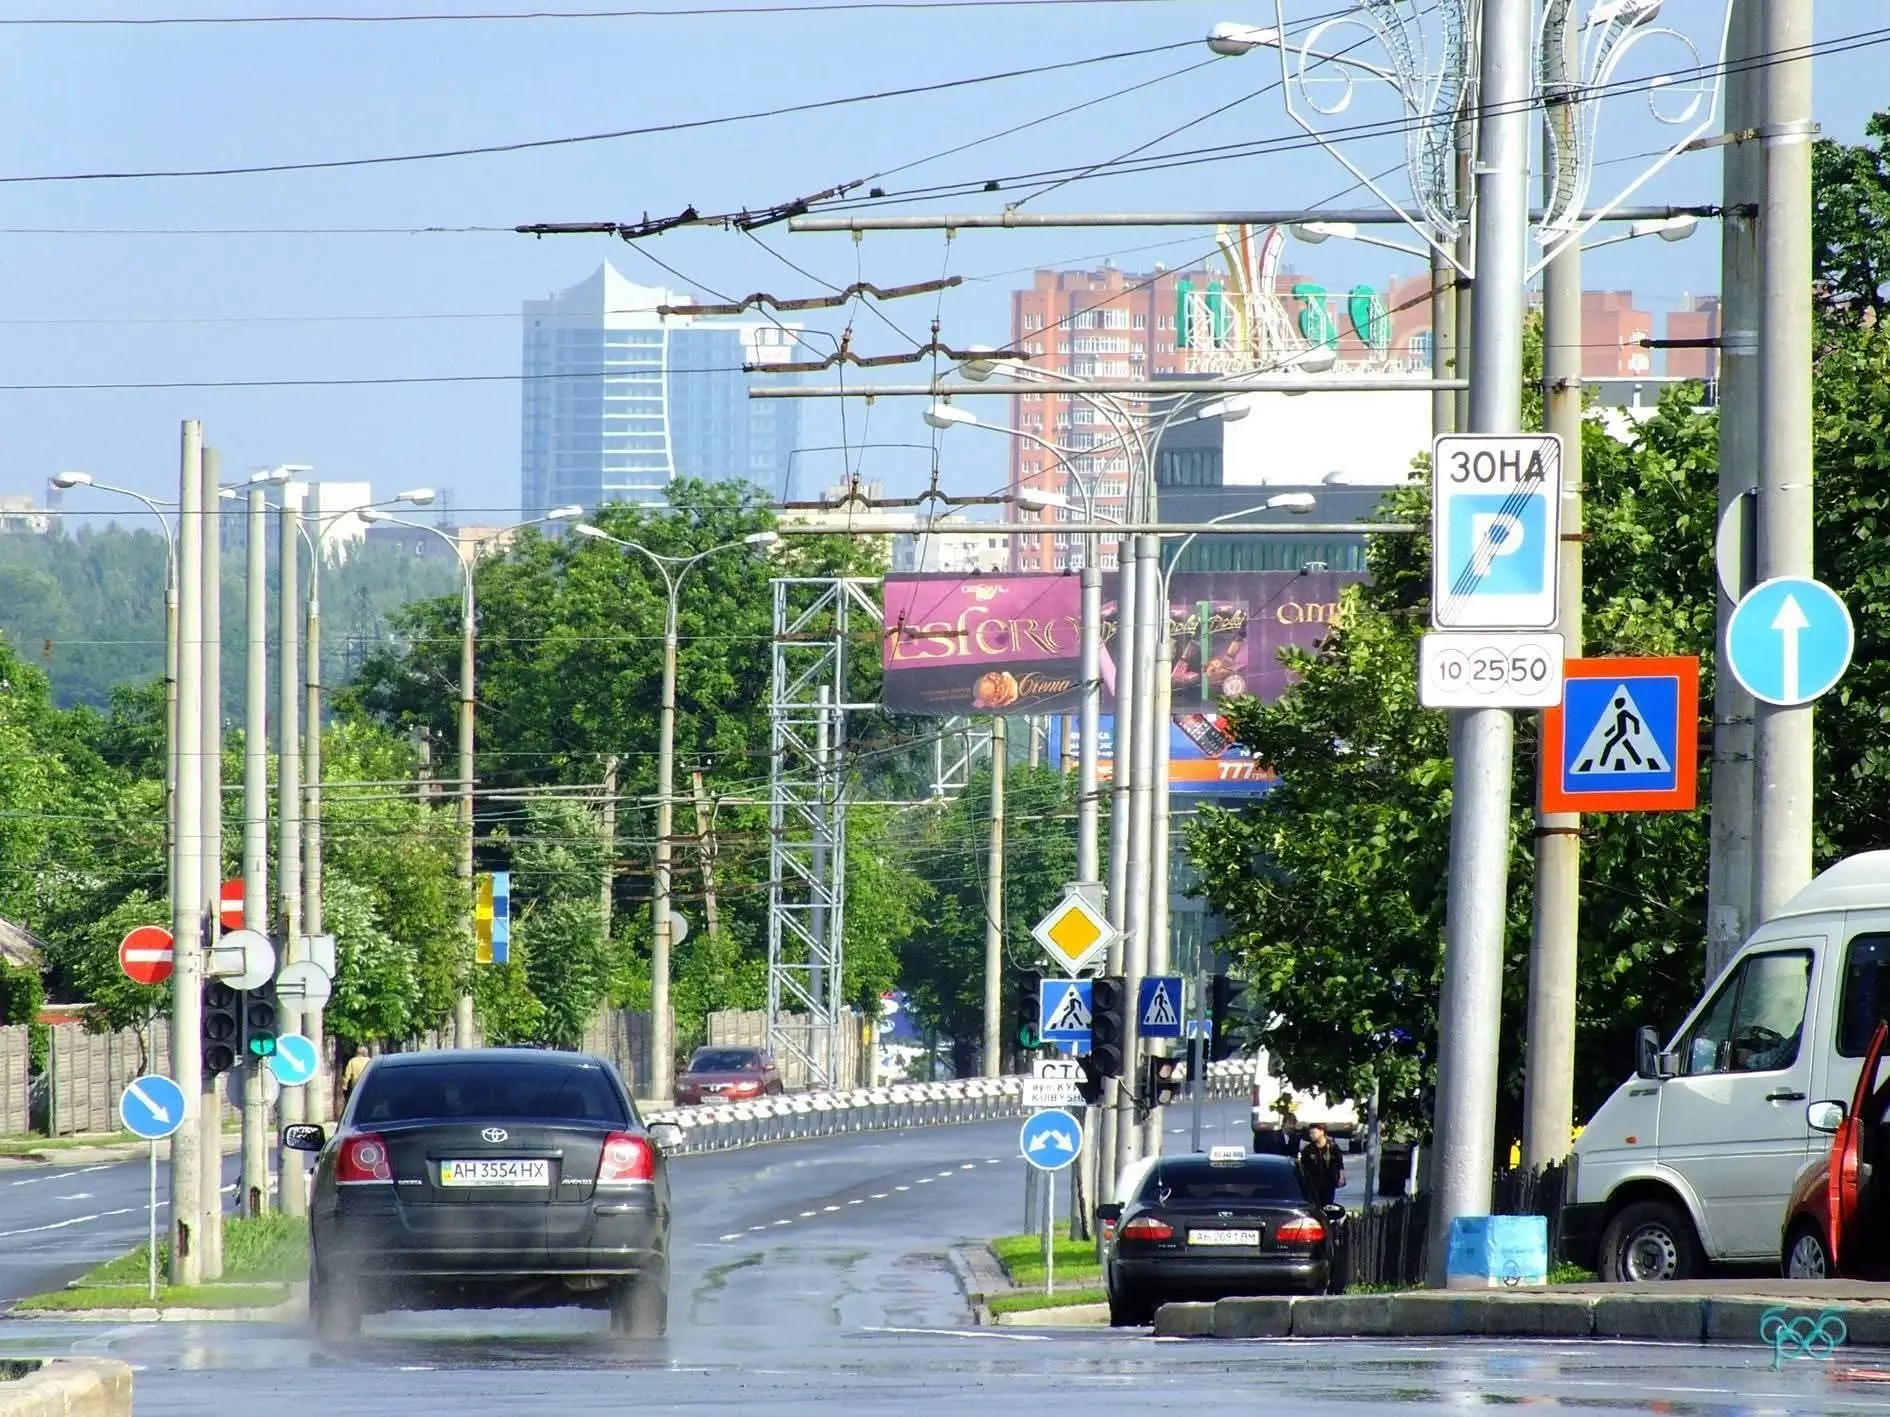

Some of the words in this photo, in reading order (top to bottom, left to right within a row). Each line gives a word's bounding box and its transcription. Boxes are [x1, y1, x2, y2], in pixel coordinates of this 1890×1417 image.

[1450, 450, 1545, 484] ЗОНА
[1440, 661, 1462, 681] 10
[1473, 660, 1504, 682] 25
[1511, 658, 1547, 682] 50
[1218, 762, 1254, 779] 777
[453, 1163, 476, 1178] AH
[481, 1163, 517, 1178] 3554
[520, 1163, 544, 1178] HX
